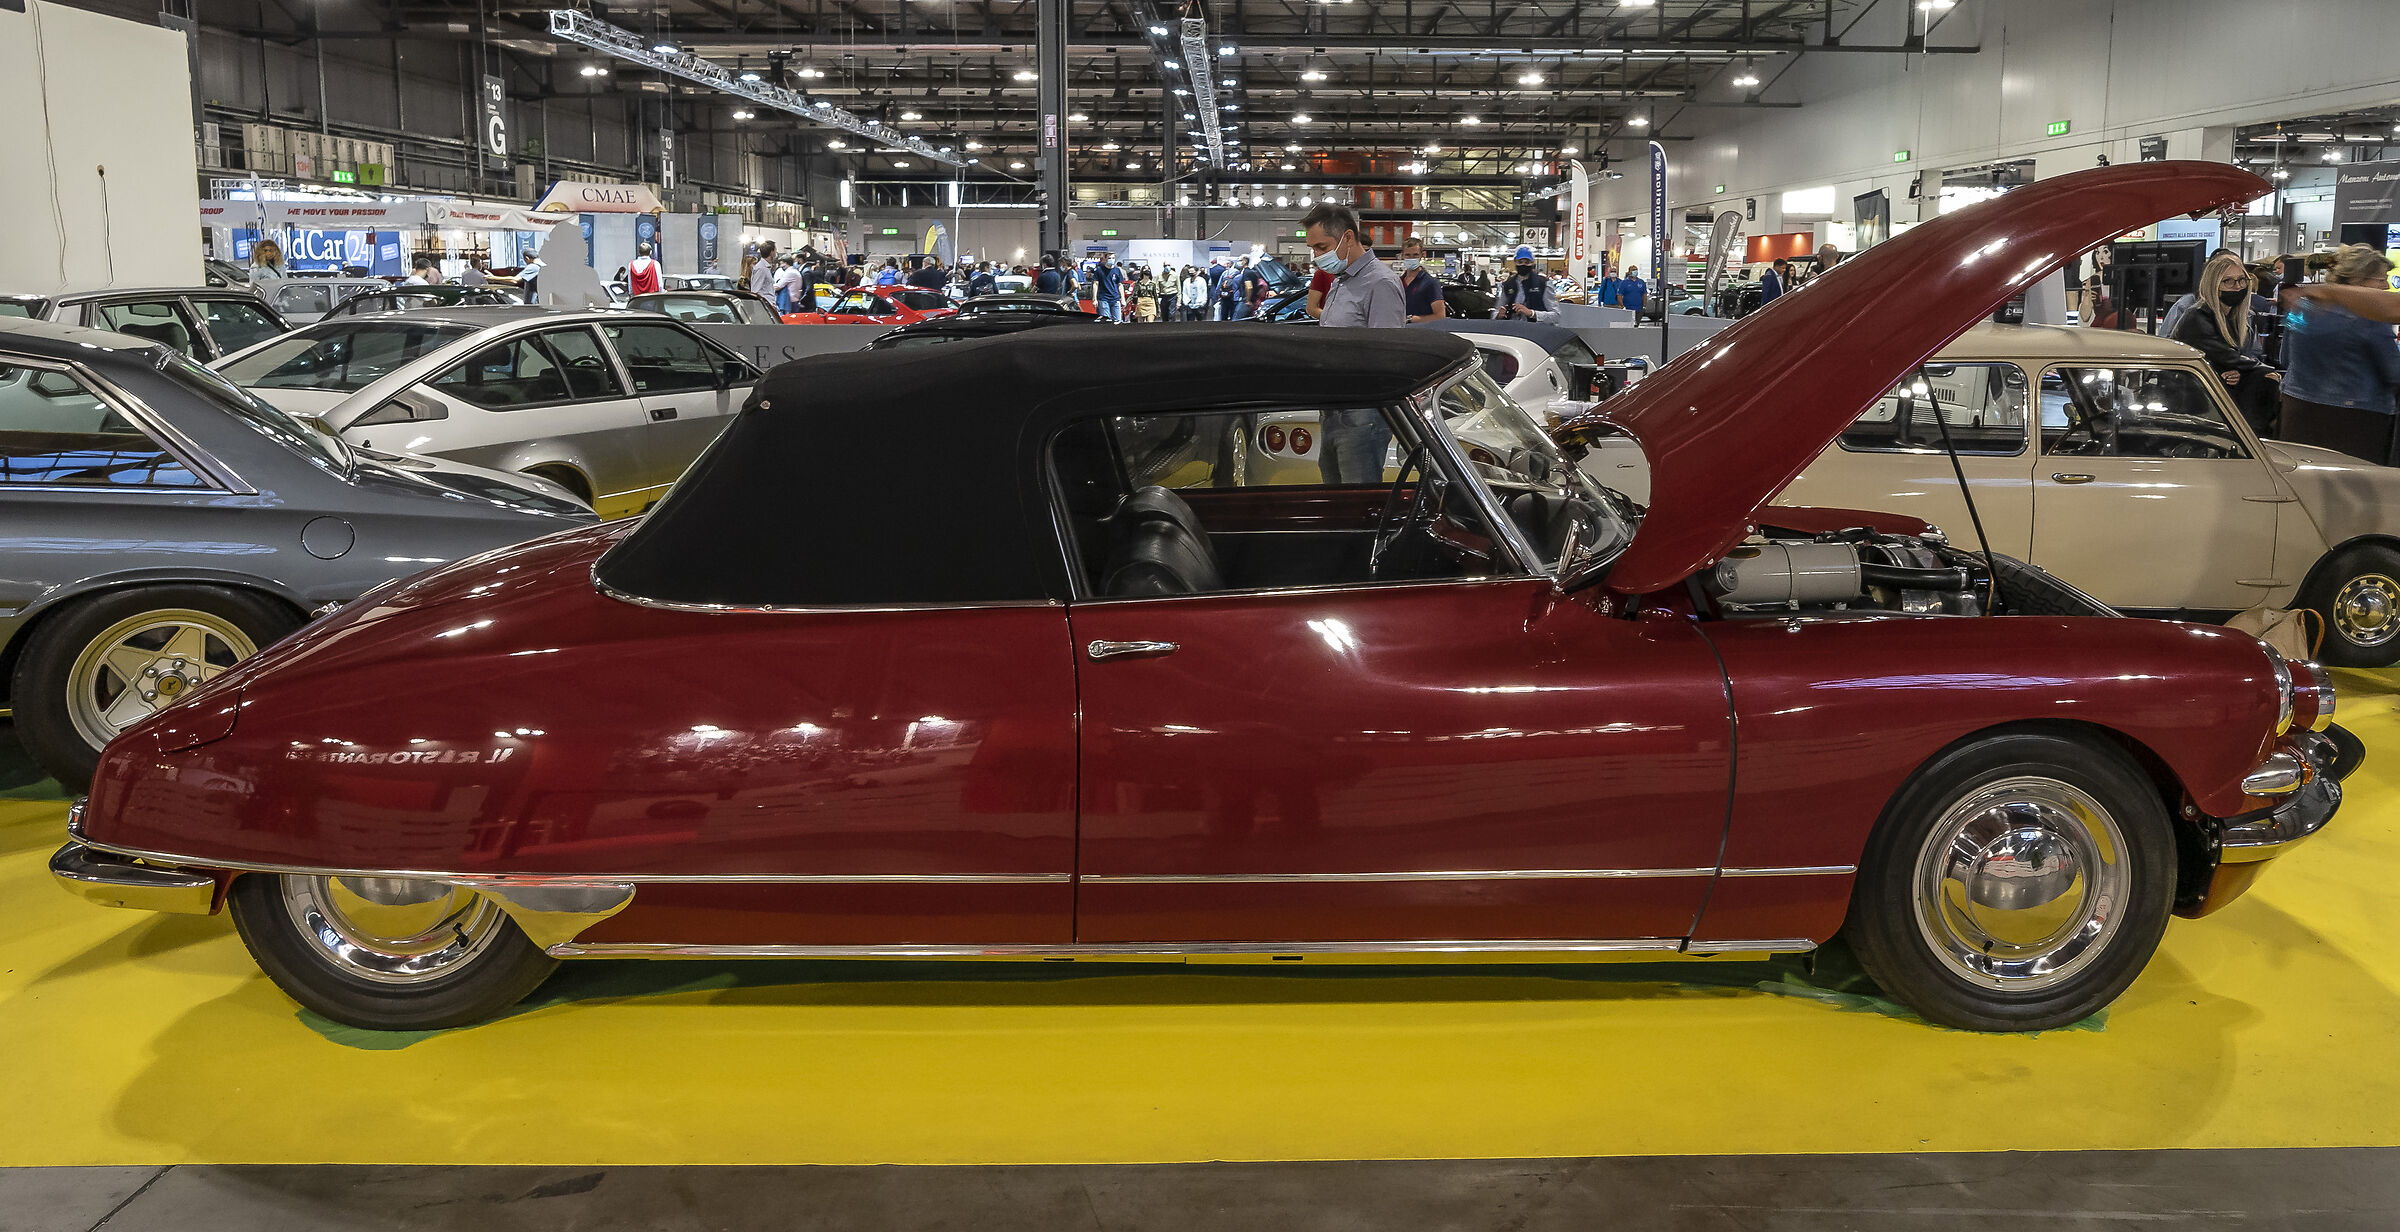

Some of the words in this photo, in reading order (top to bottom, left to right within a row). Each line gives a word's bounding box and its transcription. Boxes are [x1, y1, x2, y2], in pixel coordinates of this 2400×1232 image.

[491, 84, 502, 101] 13
[489, 116, 506, 155] G
[665, 136, 672, 150] 13
[663, 160, 674, 189] H
[582, 187, 636, 204] CMAE
[287, 208, 301, 216] WE
[303, 208, 327, 216] MOVE
[329, 208, 349, 216] YOUR
[352, 208, 387, 216] PASSION
[349, 235, 368, 261] 24
[2297, 235, 2305, 246] R
